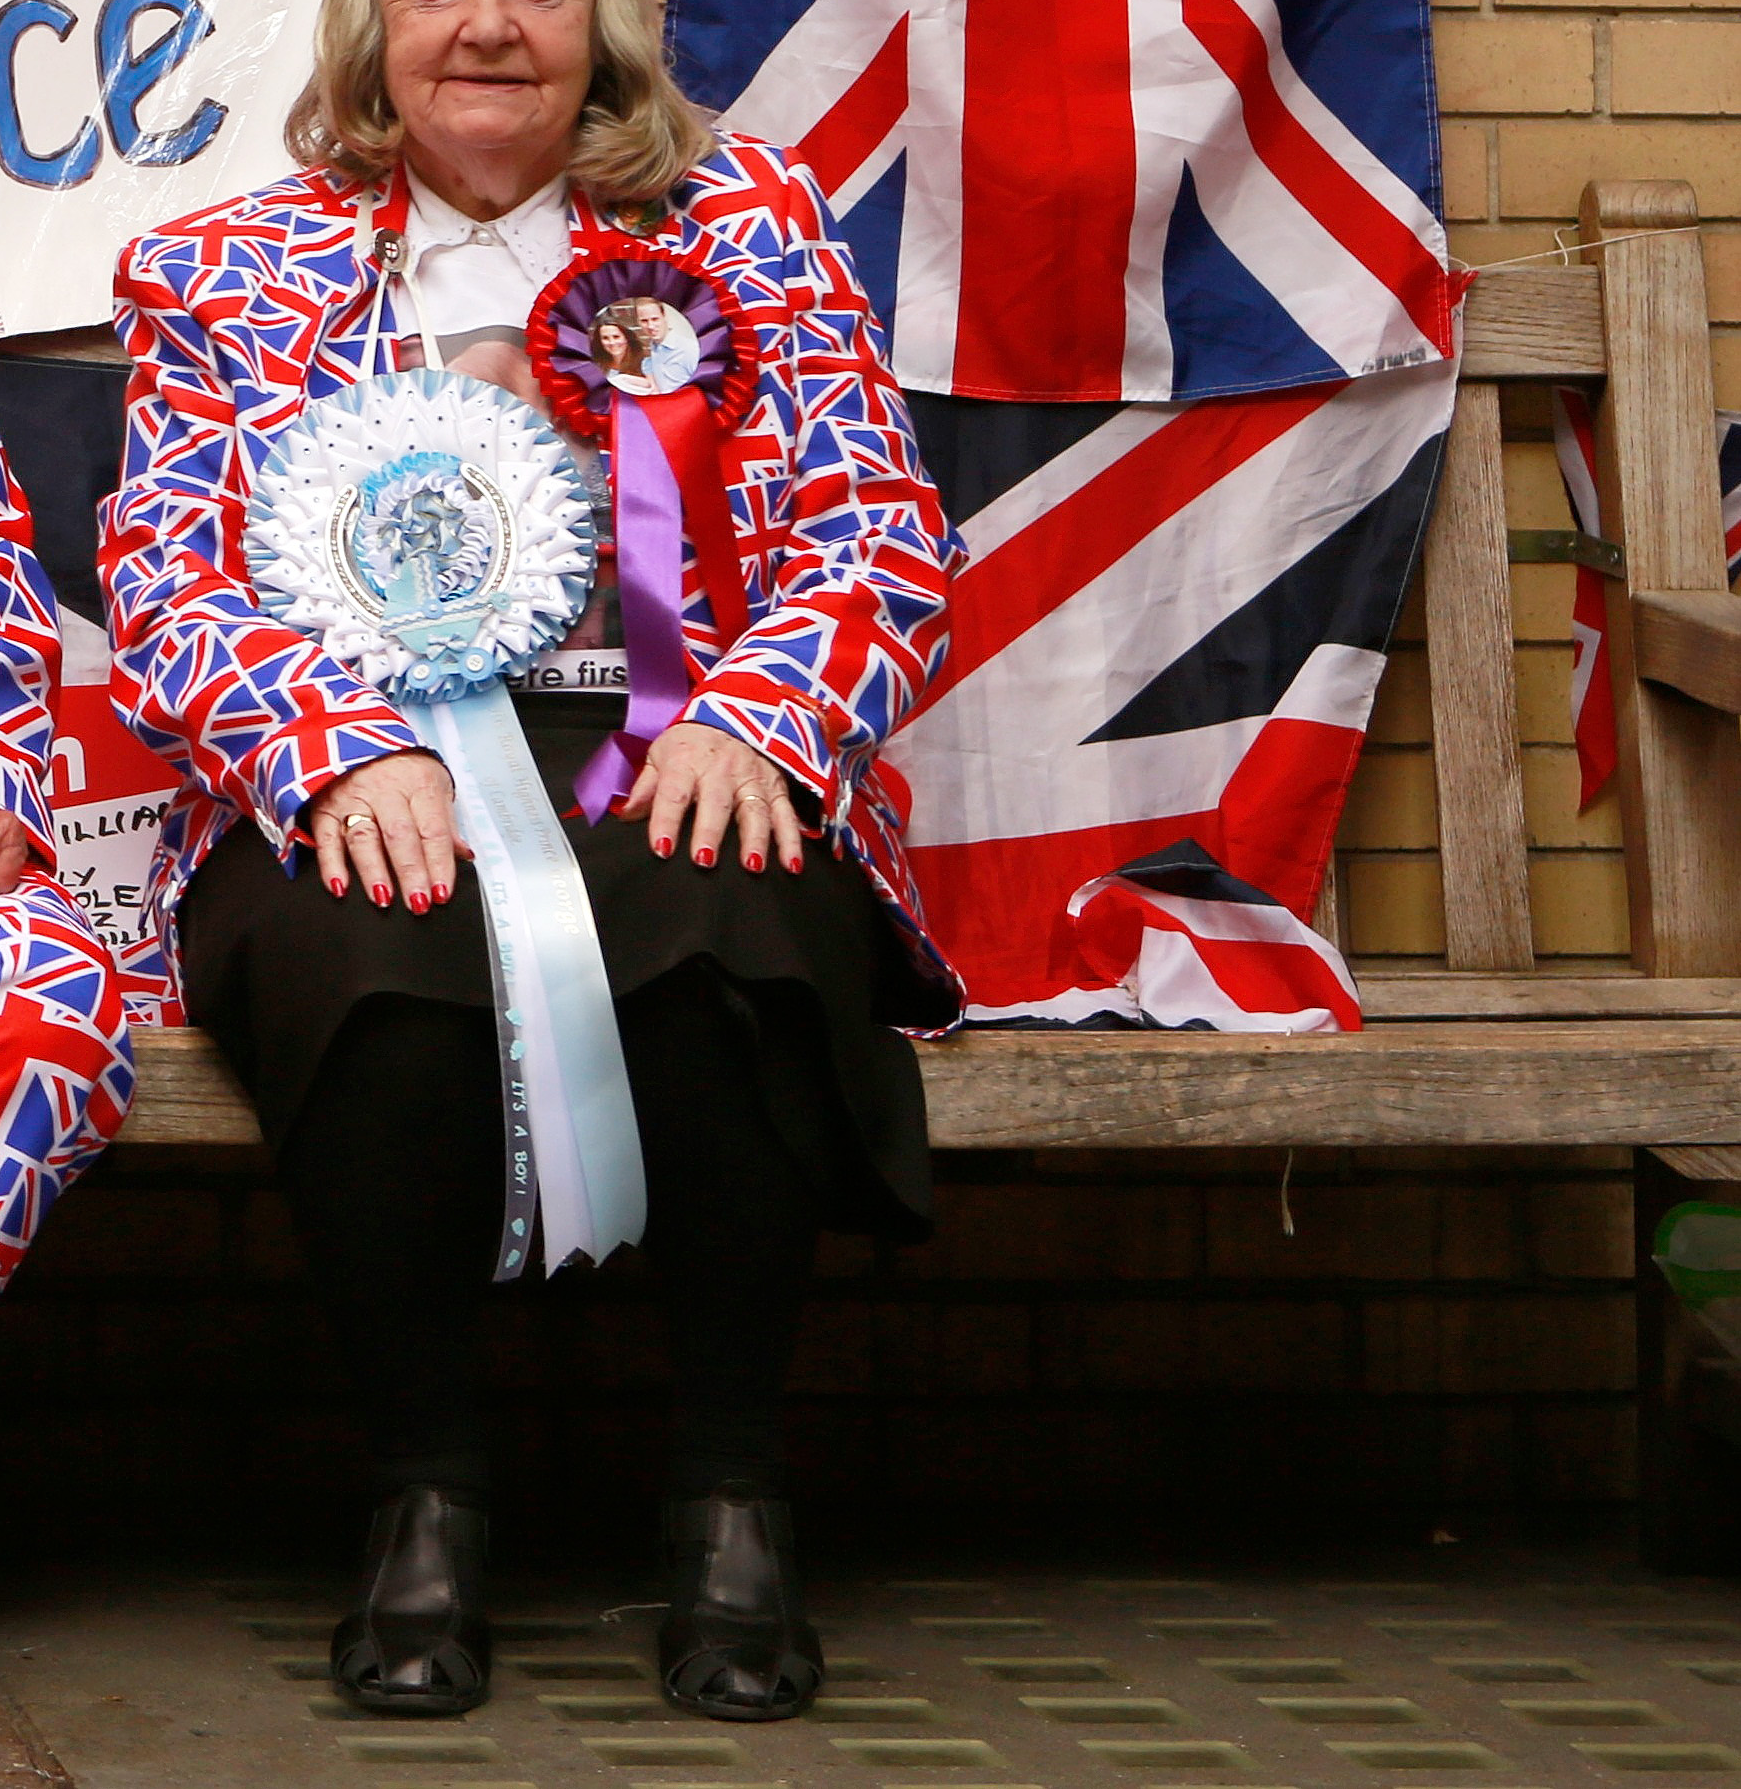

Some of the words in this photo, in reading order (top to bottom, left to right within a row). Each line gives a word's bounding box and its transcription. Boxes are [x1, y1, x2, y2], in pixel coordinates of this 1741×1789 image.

[577, 660, 627, 686] firs
[61, 802, 170, 844] ILLIA
[511, 1080, 527, 1112] IT'S
[514, 1125, 528, 1137] A
